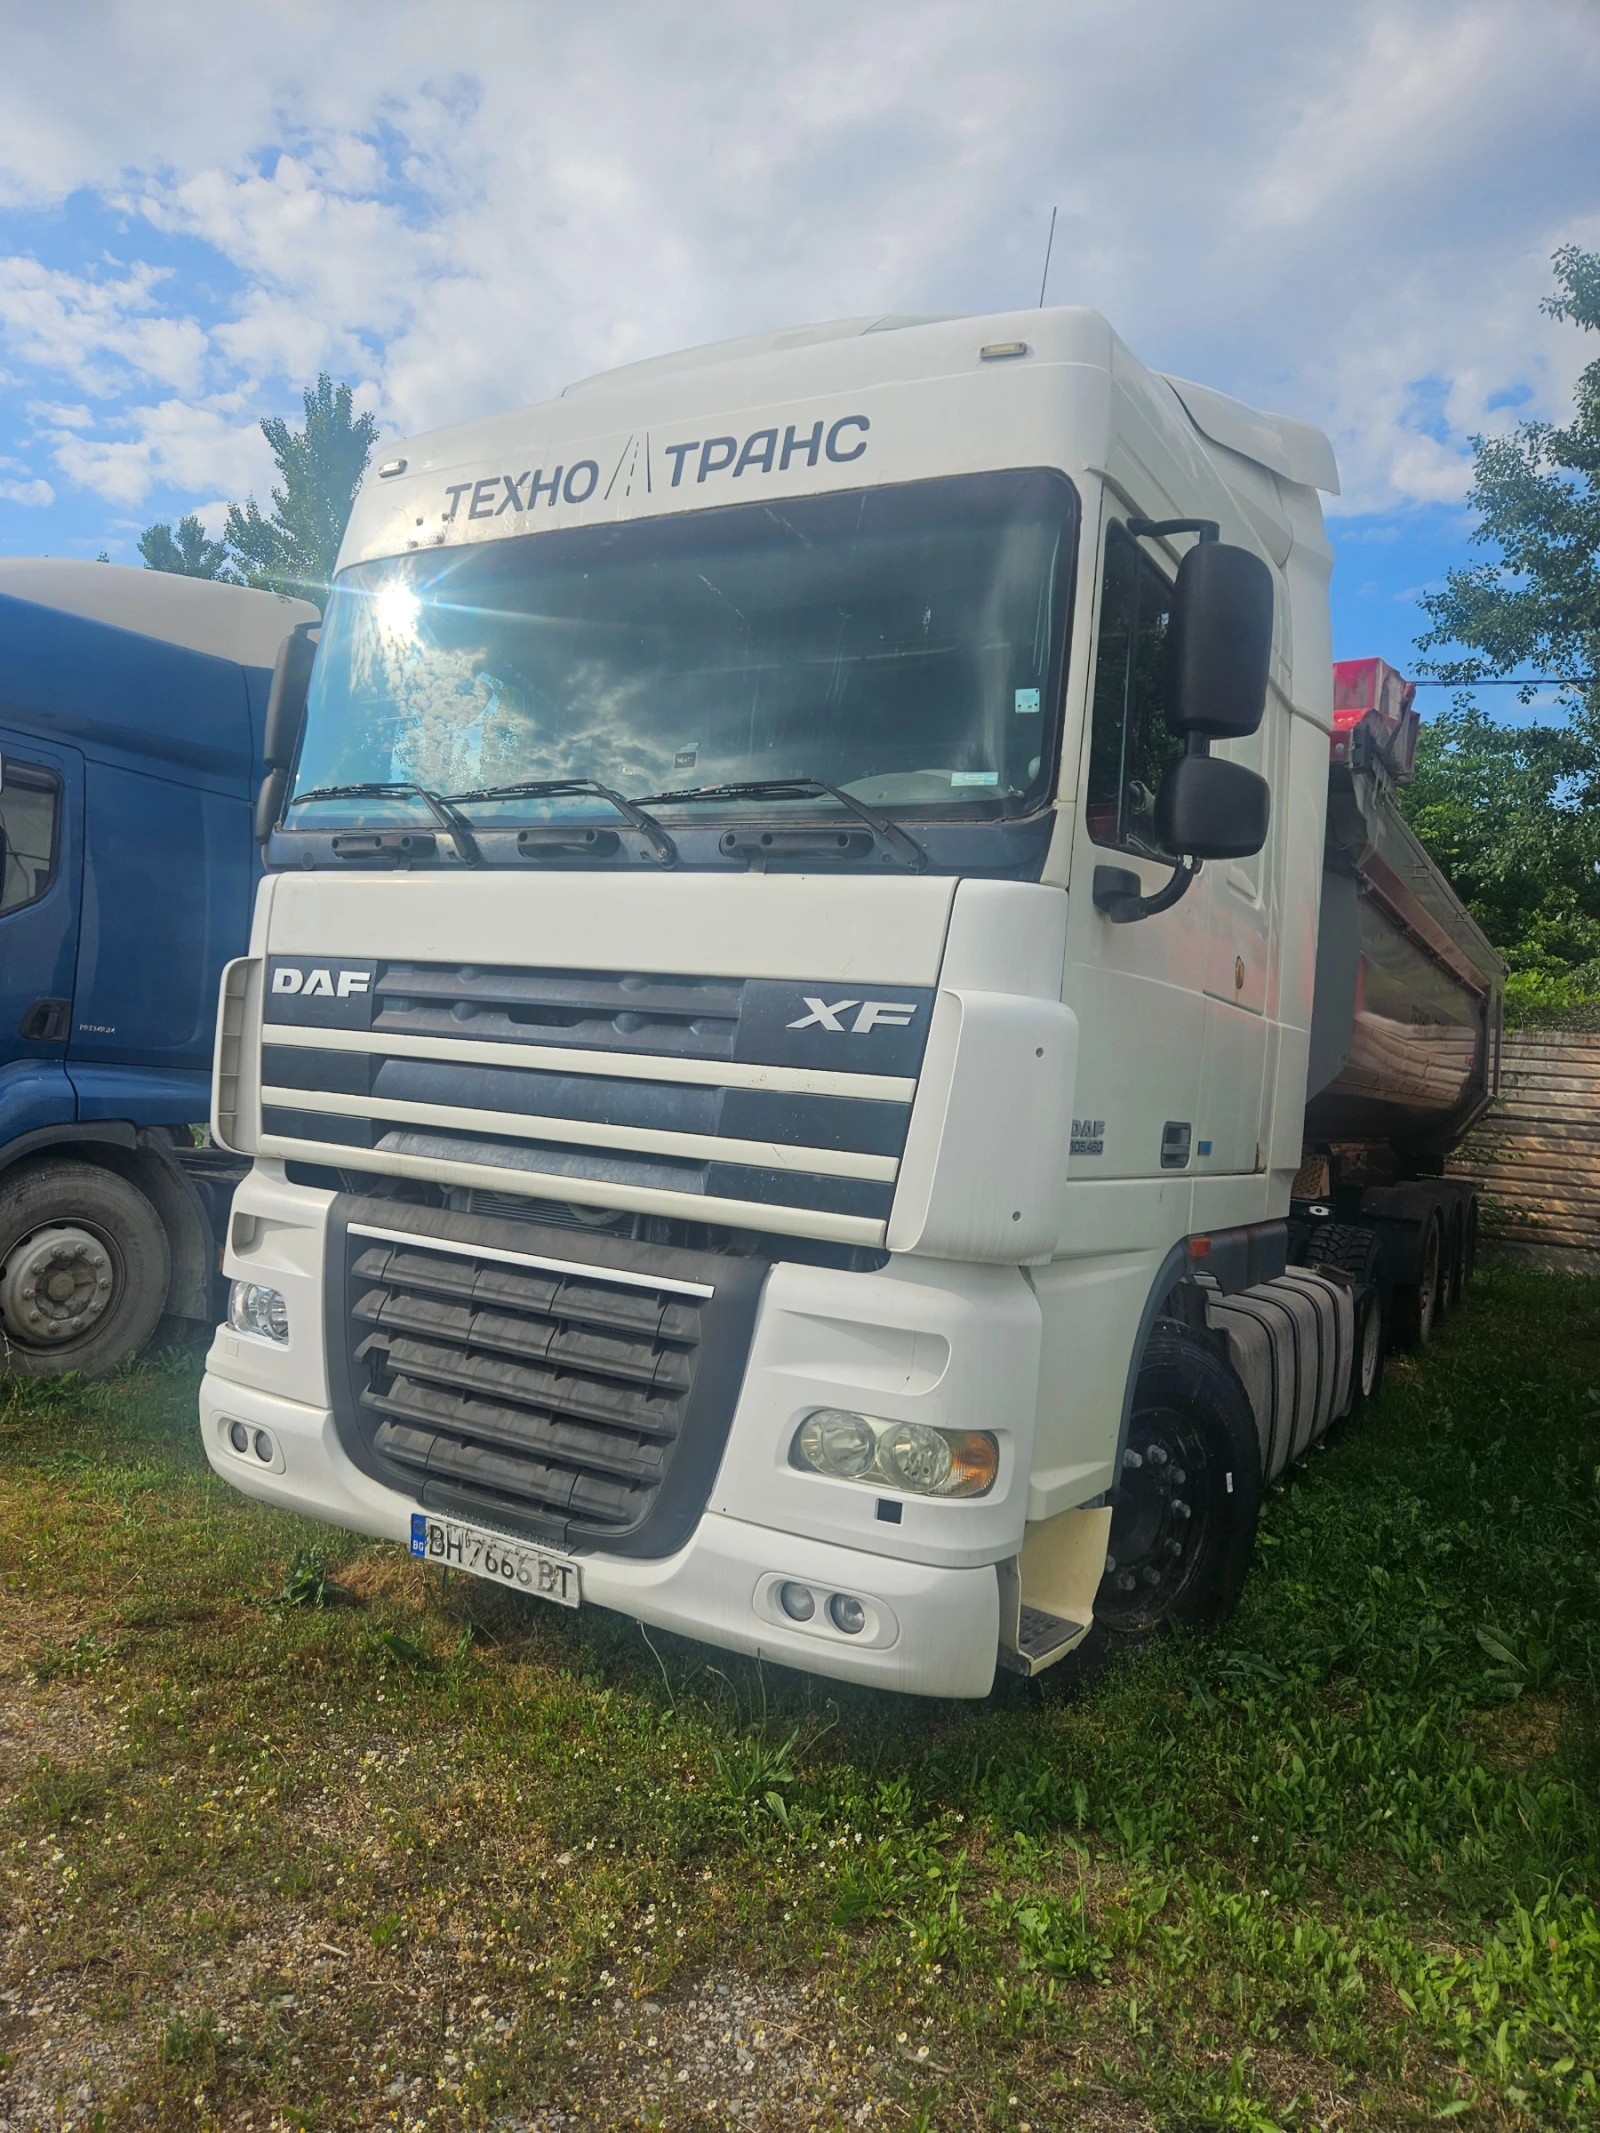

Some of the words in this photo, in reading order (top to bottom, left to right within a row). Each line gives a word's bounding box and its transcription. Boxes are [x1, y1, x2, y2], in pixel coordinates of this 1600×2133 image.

[445, 459, 599, 521] ТЕХНО
[665, 415, 870, 488] ТРАНС
[271, 967, 371, 998] DAF
[785, 997, 918, 1034] XF
[1071, 1119, 1105, 1138] DAF
[412, 1539, 424, 1551] BG
